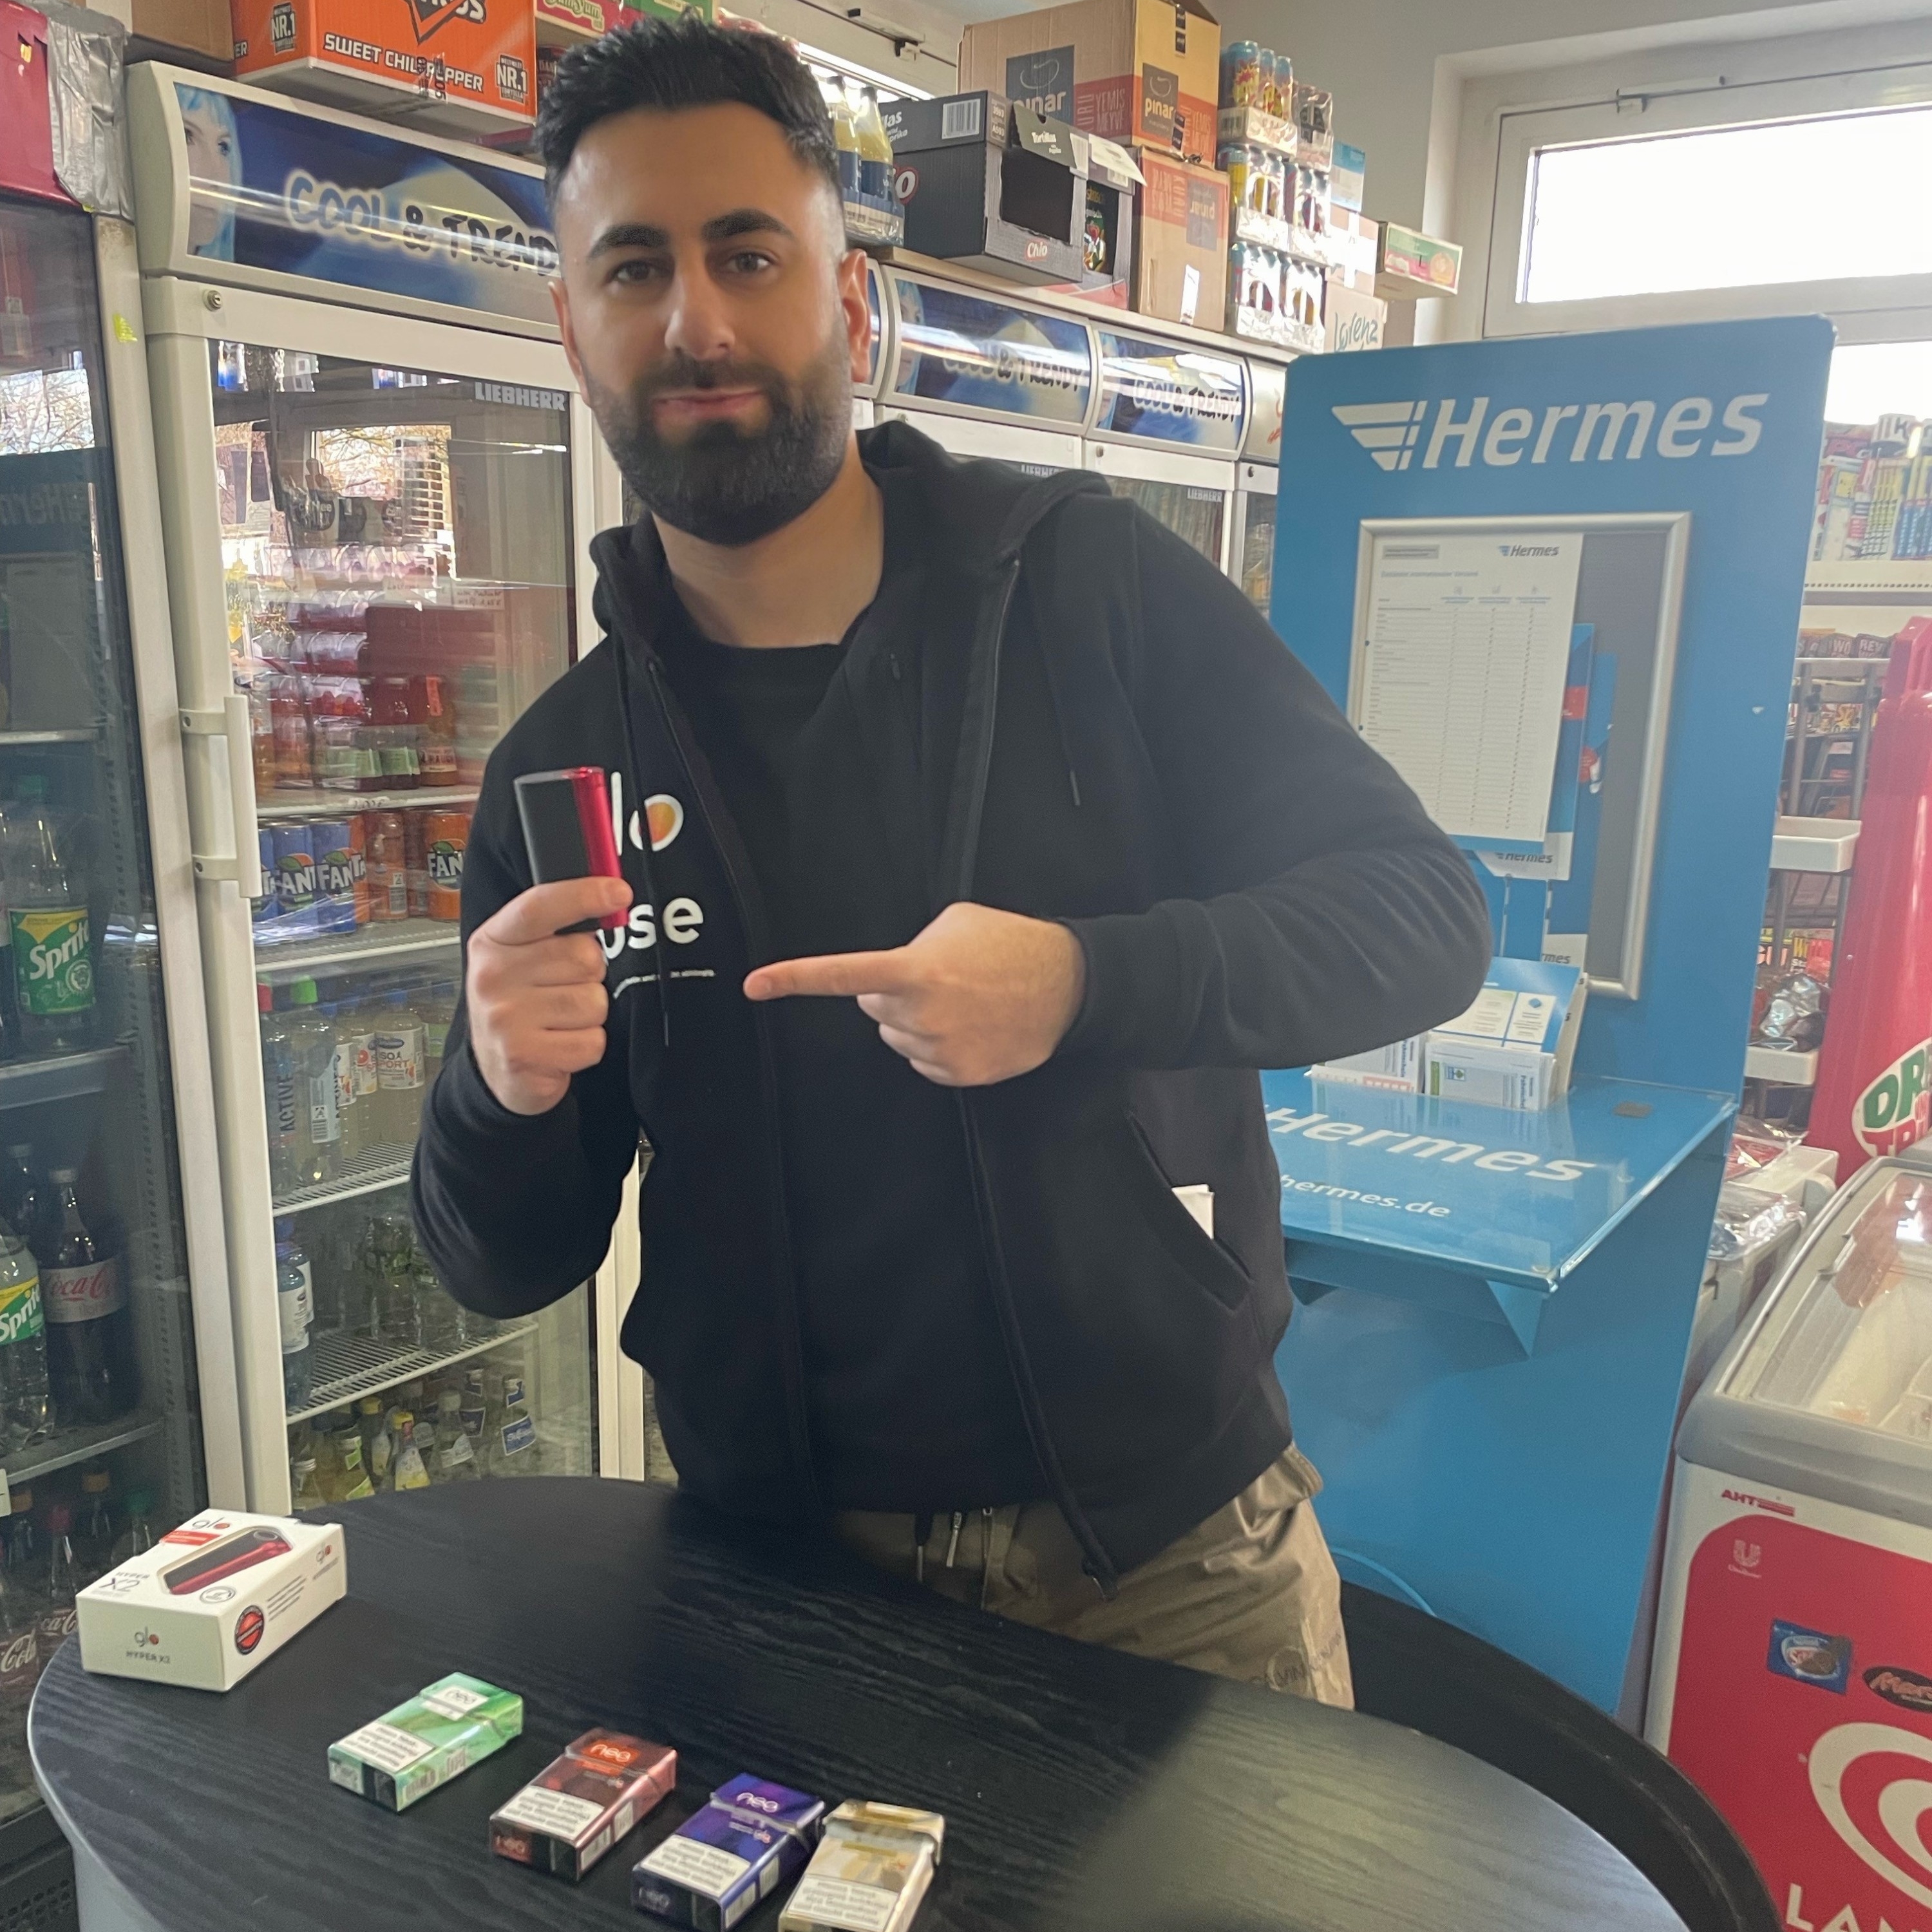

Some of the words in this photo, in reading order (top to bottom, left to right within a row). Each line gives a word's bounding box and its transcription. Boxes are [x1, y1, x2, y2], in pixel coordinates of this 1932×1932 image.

[270, 12, 296, 41] NR.1
[324, 33, 382, 63] SWEET
[385, 50, 426, 75] CHIL
[497, 62, 527, 92] NR.1
[289, 176, 391, 242] COOL
[1027, 242, 1048, 258] Chio
[1334, 311, 1378, 351] Lorenz
[475, 381, 566, 412] LIEBHERR
[1422, 392, 1771, 469] Hermes
[1187, 488, 1223, 503] LIEBHERR
[1510, 544, 1560, 557] Hermes
[1266, 1108, 1598, 1182] Hermes
[98, 1577, 140, 1592] X2
[133, 1626, 160, 1647] glo
[126, 1650, 156, 1663] HYPER
[589, 1743, 632, 1763] neo
[736, 1792, 780, 1814] neo
